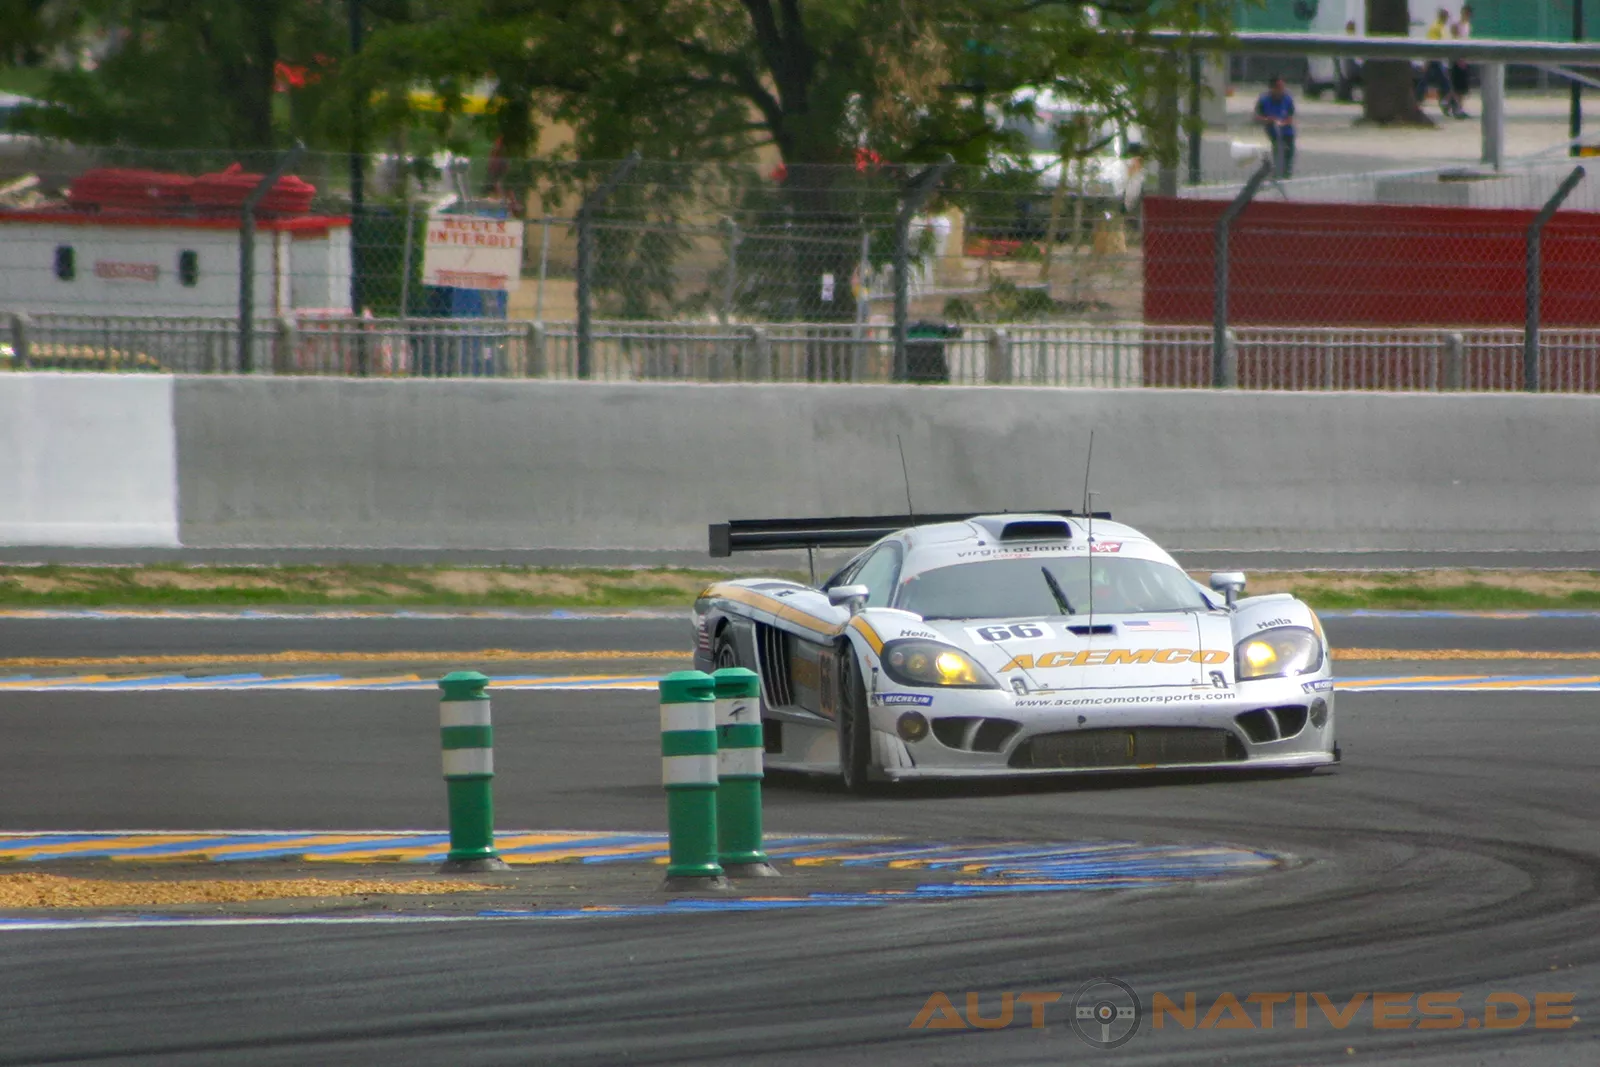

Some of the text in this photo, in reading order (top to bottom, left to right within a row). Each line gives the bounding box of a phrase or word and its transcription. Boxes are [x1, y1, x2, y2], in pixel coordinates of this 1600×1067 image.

[430, 230, 517, 249] INTERDIT
[956, 544, 1086, 557] virgin atlantic
[1256, 618, 1292, 629] Hella
[900, 629, 937, 639] Hella
[976, 623, 1044, 642] 66
[997, 648, 1230, 672] ACEMCO
[885, 695, 930, 703] MICHELIN
[1015, 691, 1236, 707] www.acemcomotorsports.com
